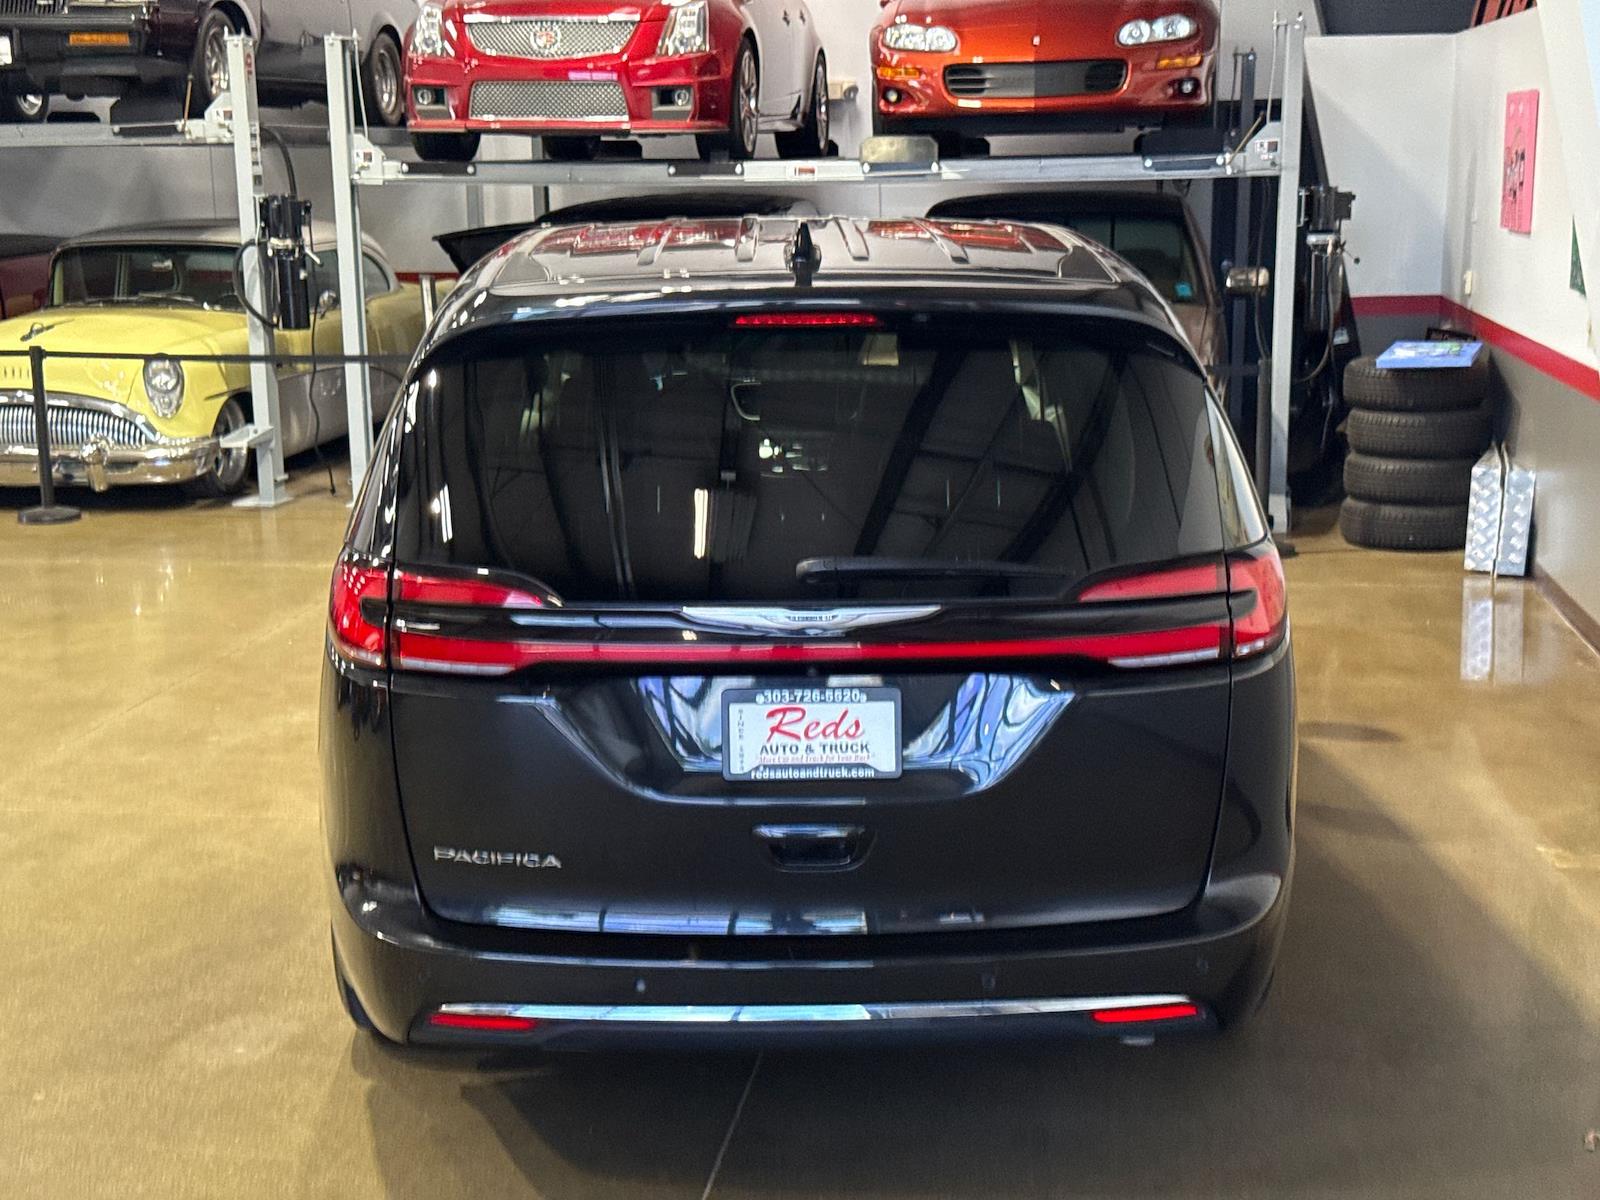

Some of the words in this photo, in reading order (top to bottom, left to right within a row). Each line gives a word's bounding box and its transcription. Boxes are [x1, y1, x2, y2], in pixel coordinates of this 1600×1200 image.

[765, 706, 864, 743] Reds
[760, 744, 799, 755] AUTO
[805, 744, 815, 754] &
[820, 743, 870, 754] TRUCK
[751, 766, 875, 779] redsautoandtruck.com
[433, 845, 562, 869] PACIFICA
